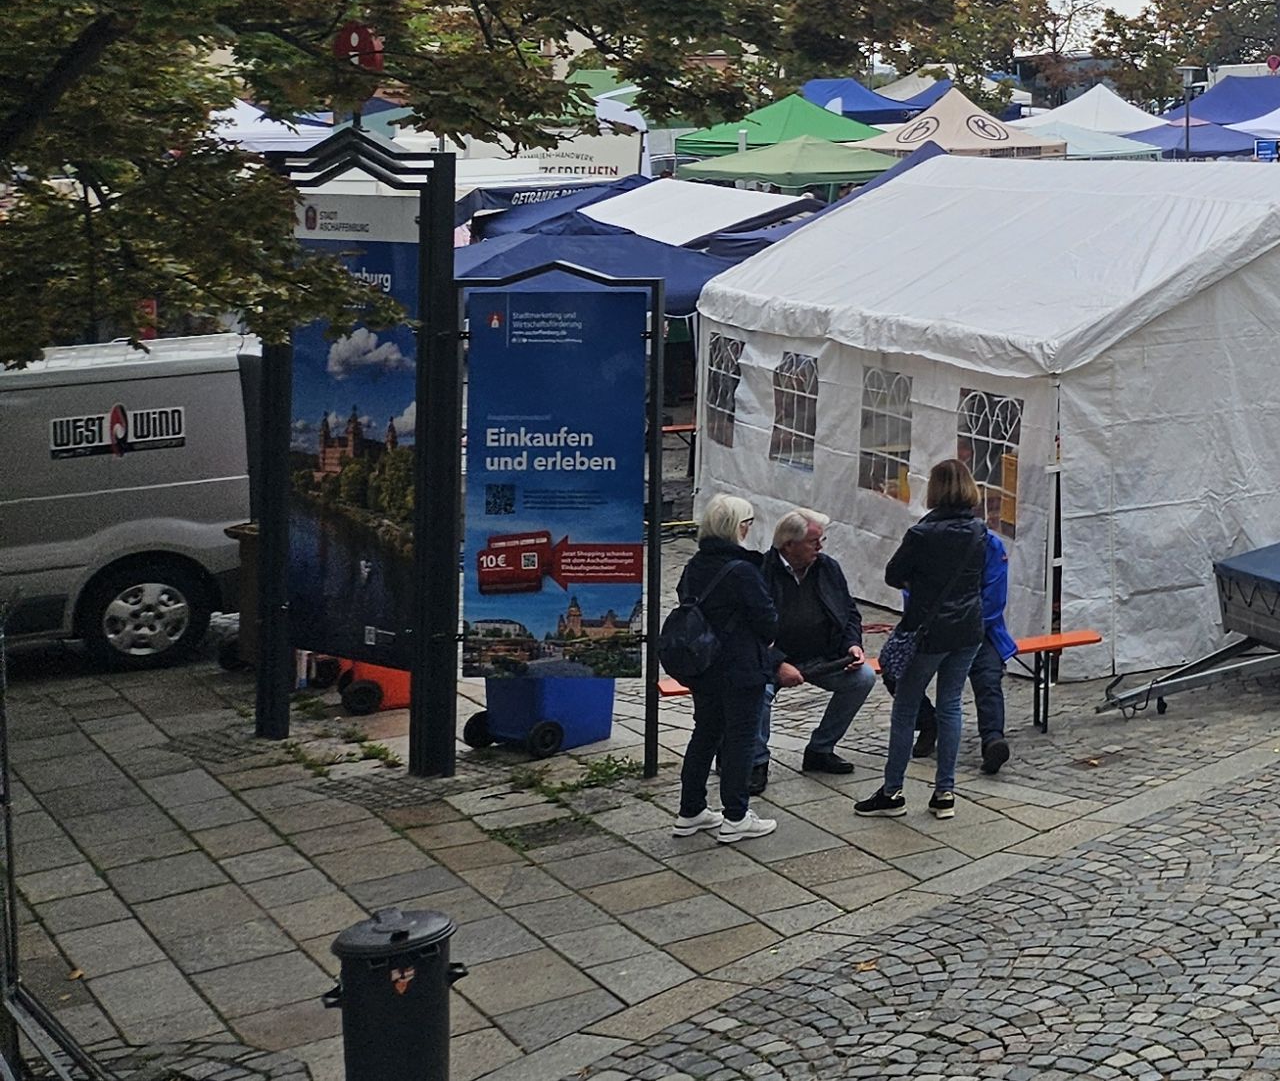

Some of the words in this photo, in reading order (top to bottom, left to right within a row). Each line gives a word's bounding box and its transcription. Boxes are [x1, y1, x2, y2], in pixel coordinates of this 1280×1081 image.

[52, 415, 105, 448] WEST
[485, 426, 594, 447] Einkaufen
[485, 451, 528, 471] und
[532, 450, 617, 471] erleben
